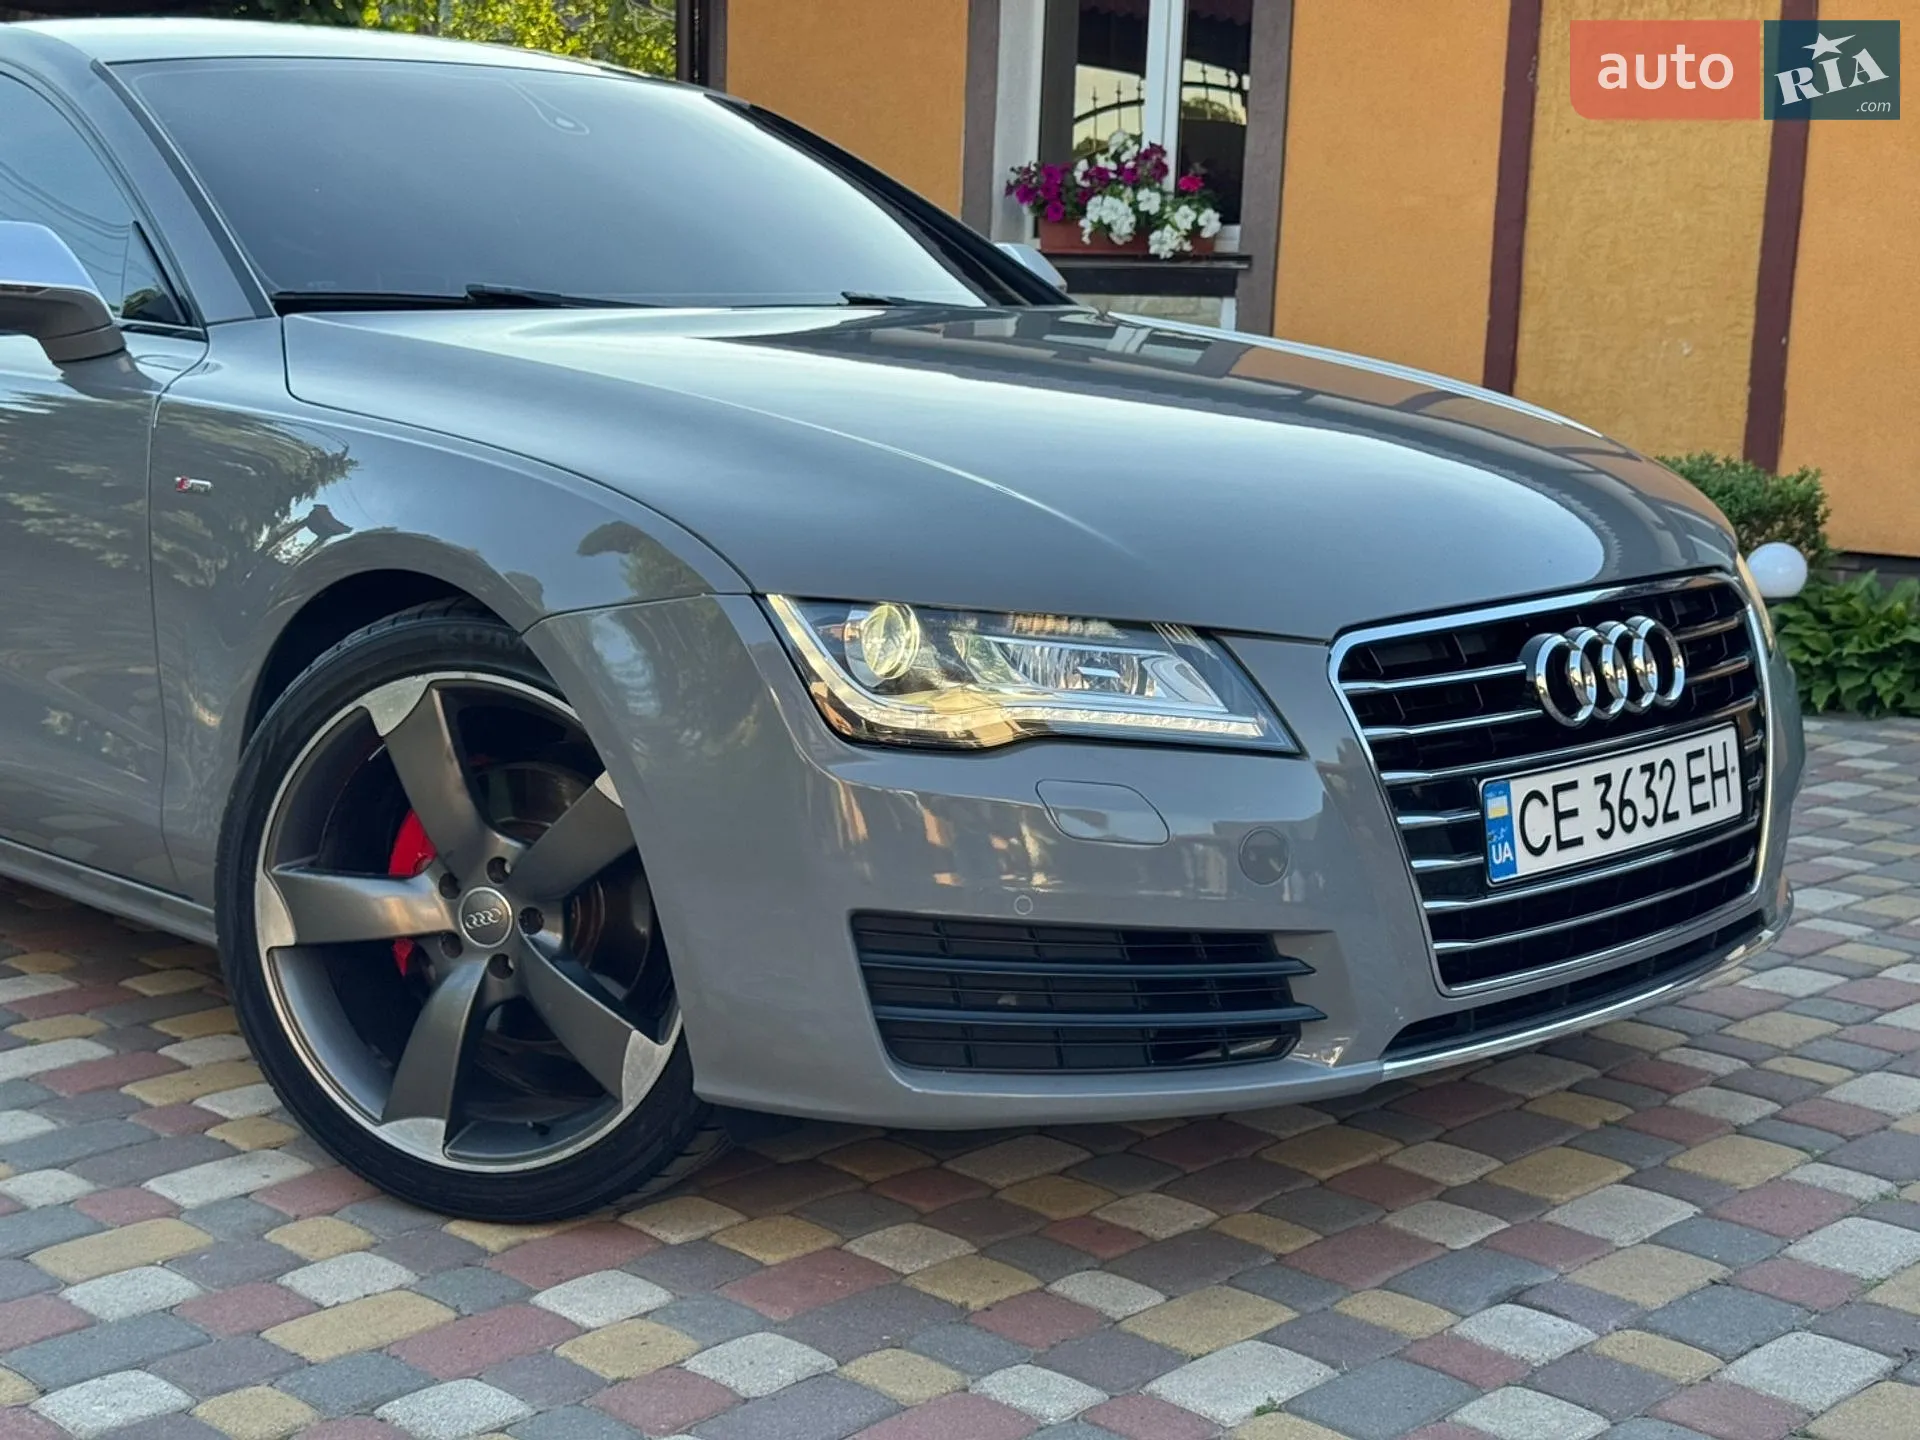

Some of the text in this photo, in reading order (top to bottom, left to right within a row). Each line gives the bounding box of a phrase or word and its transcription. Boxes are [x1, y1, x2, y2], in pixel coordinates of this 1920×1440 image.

[1519, 741, 1731, 856] CE 3632 EH
[1491, 841, 1514, 864] UA
